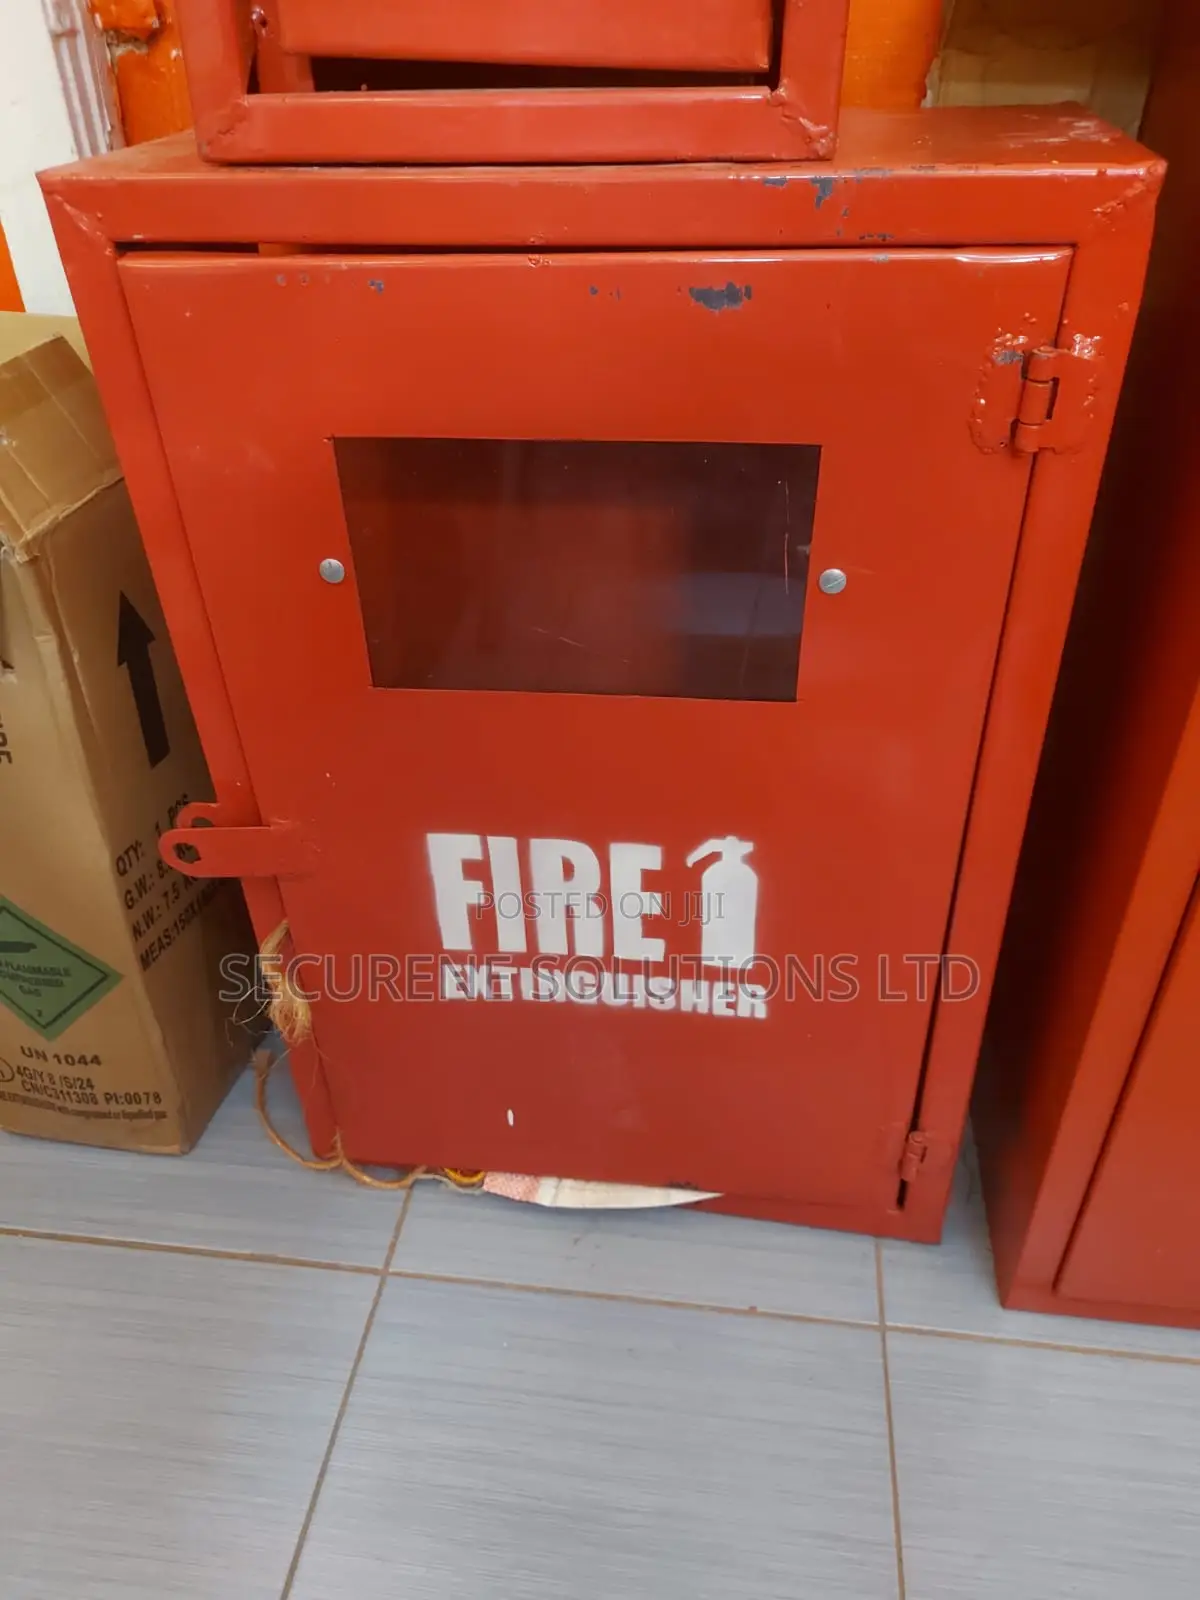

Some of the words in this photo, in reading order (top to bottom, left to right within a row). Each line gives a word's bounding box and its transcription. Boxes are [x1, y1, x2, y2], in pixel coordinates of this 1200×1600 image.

[115, 839, 147, 878] QTY:
[123, 872, 155, 911] G.W.:
[132, 904, 163, 942] N.W.:
[161, 880, 181, 912] 7.5
[425, 832, 667, 961] FIRE
[440, 962, 769, 1019] EXTINGUISHER
[20, 1045, 49, 1063] UN
[52, 1053, 102, 1067] 1044
